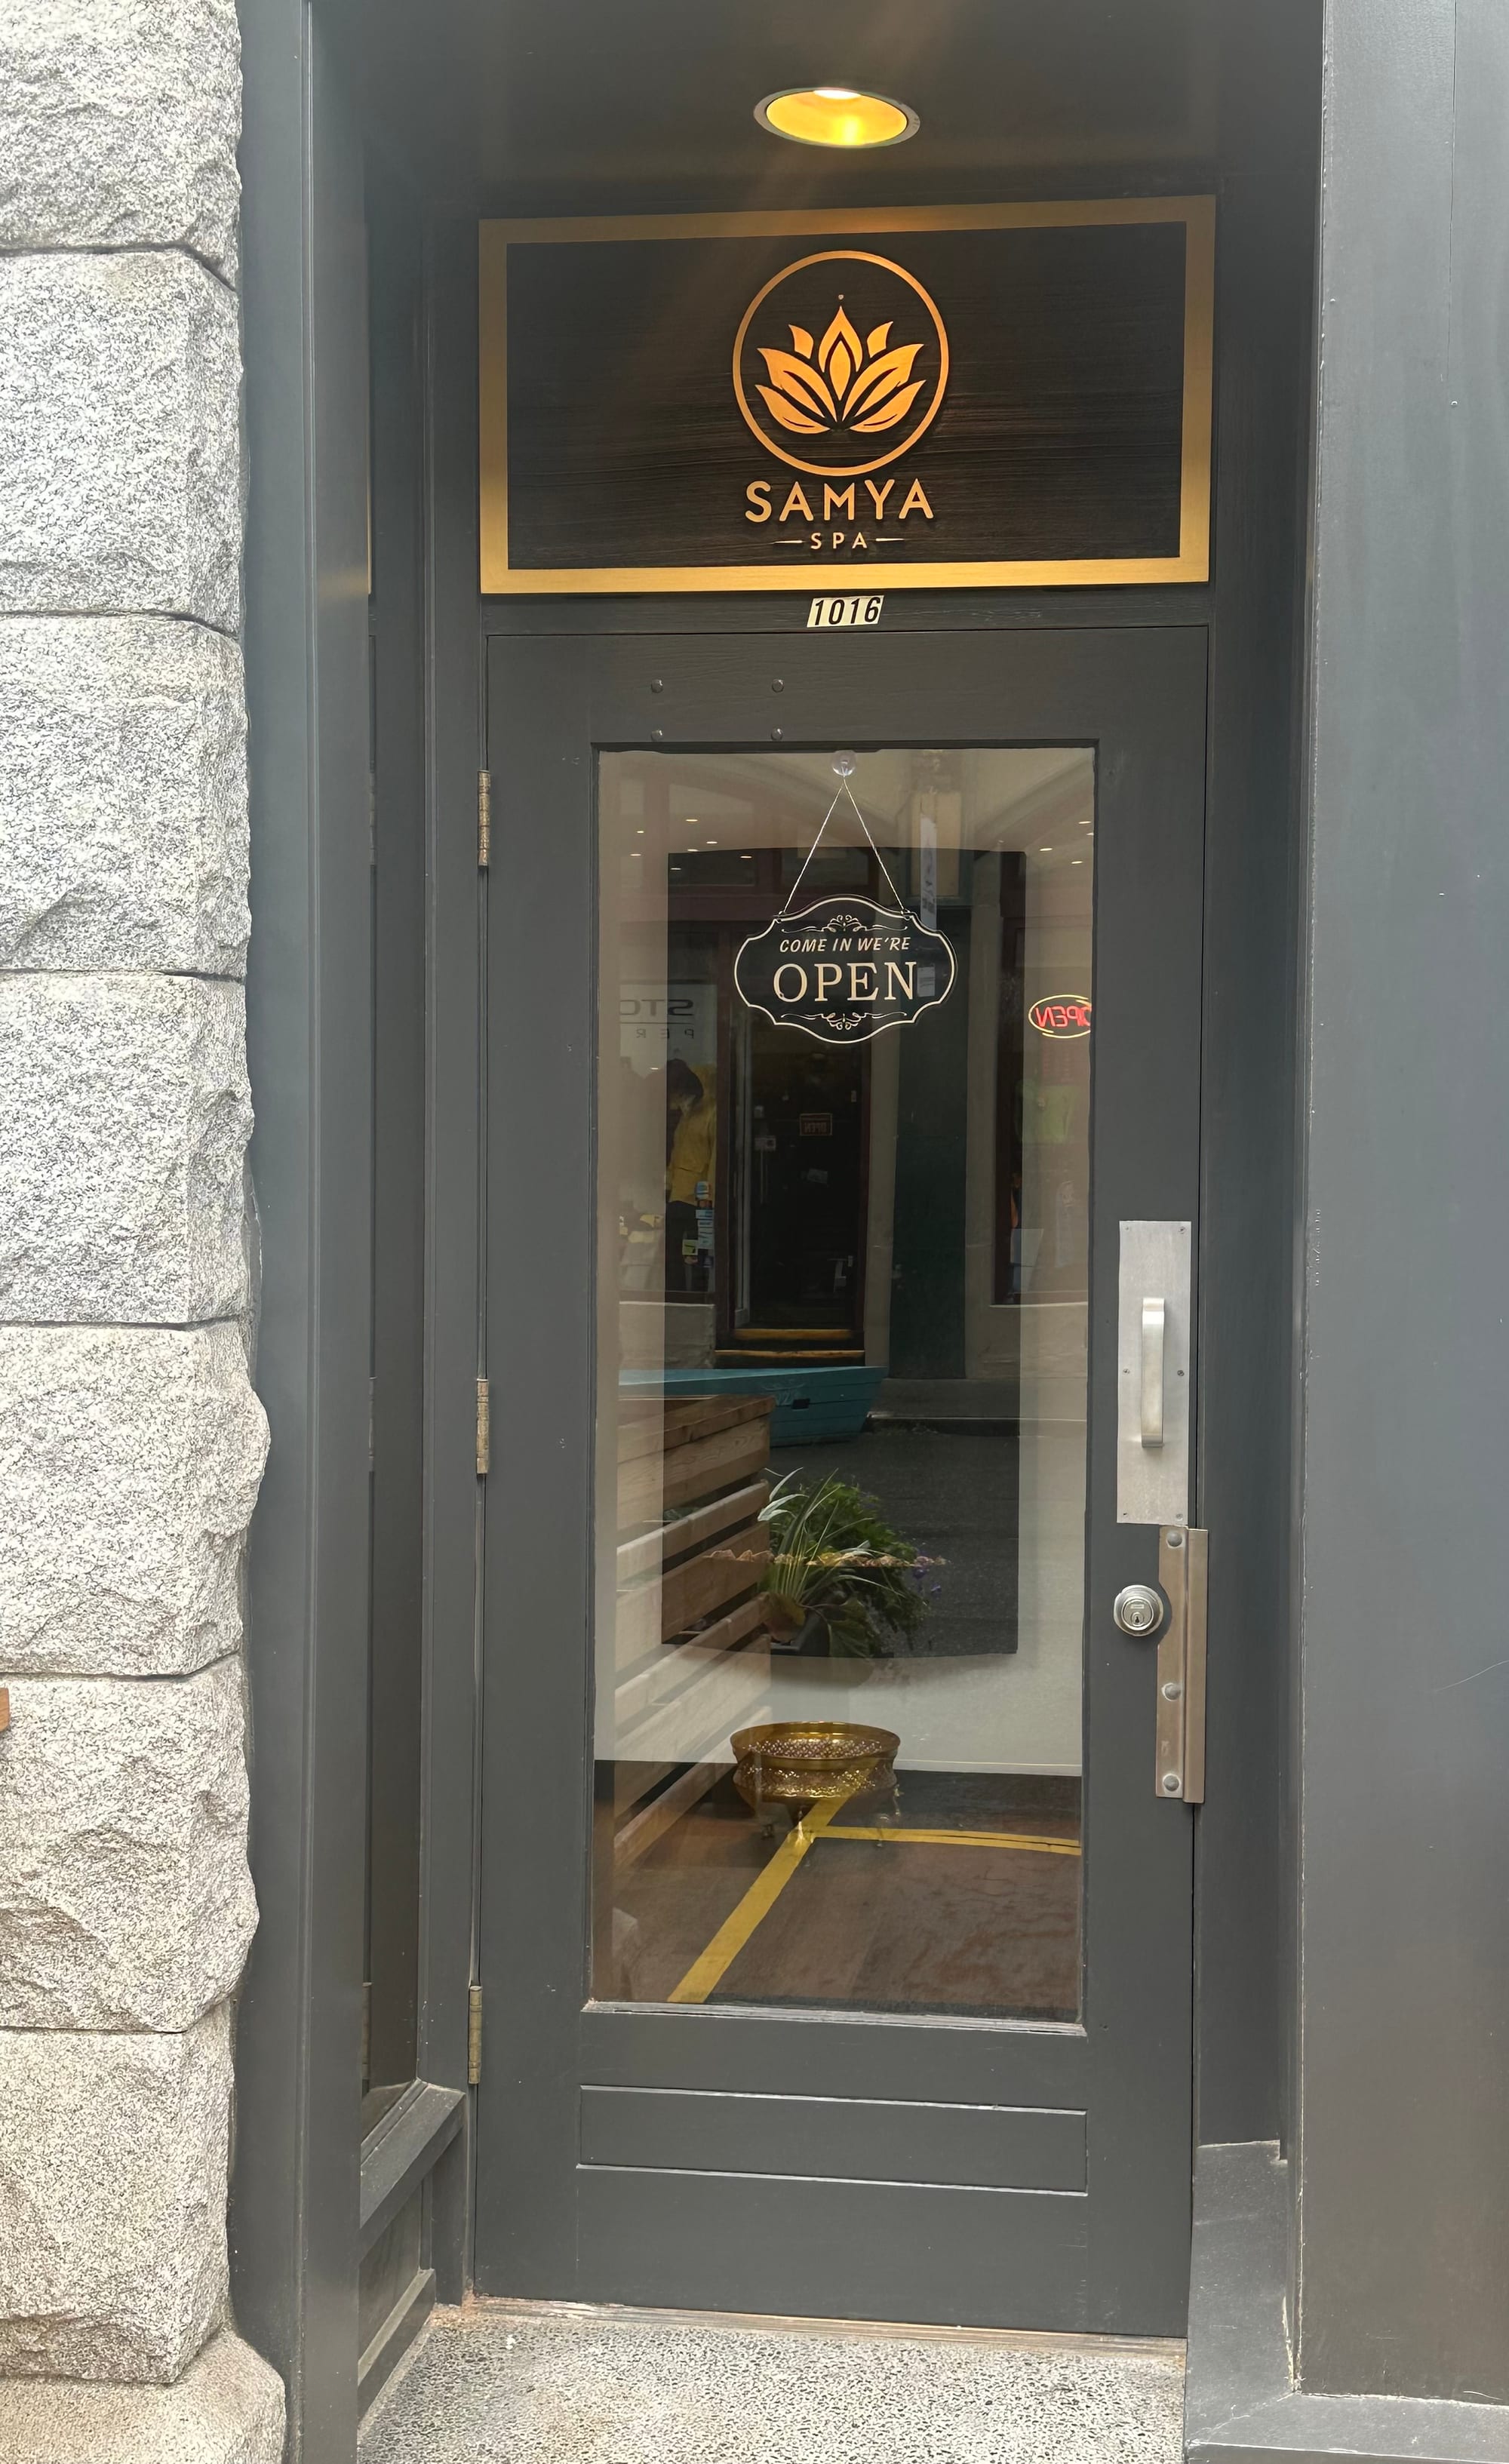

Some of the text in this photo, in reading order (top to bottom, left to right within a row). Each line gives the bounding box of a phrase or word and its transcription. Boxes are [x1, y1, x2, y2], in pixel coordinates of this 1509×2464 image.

[745, 478, 934, 523] SAMYA
[810, 531, 868, 550] SPA
[815, 597, 881, 625] 1016
[779, 936, 911, 953] COME IN WE'RE
[773, 961, 917, 1003] OPEN
